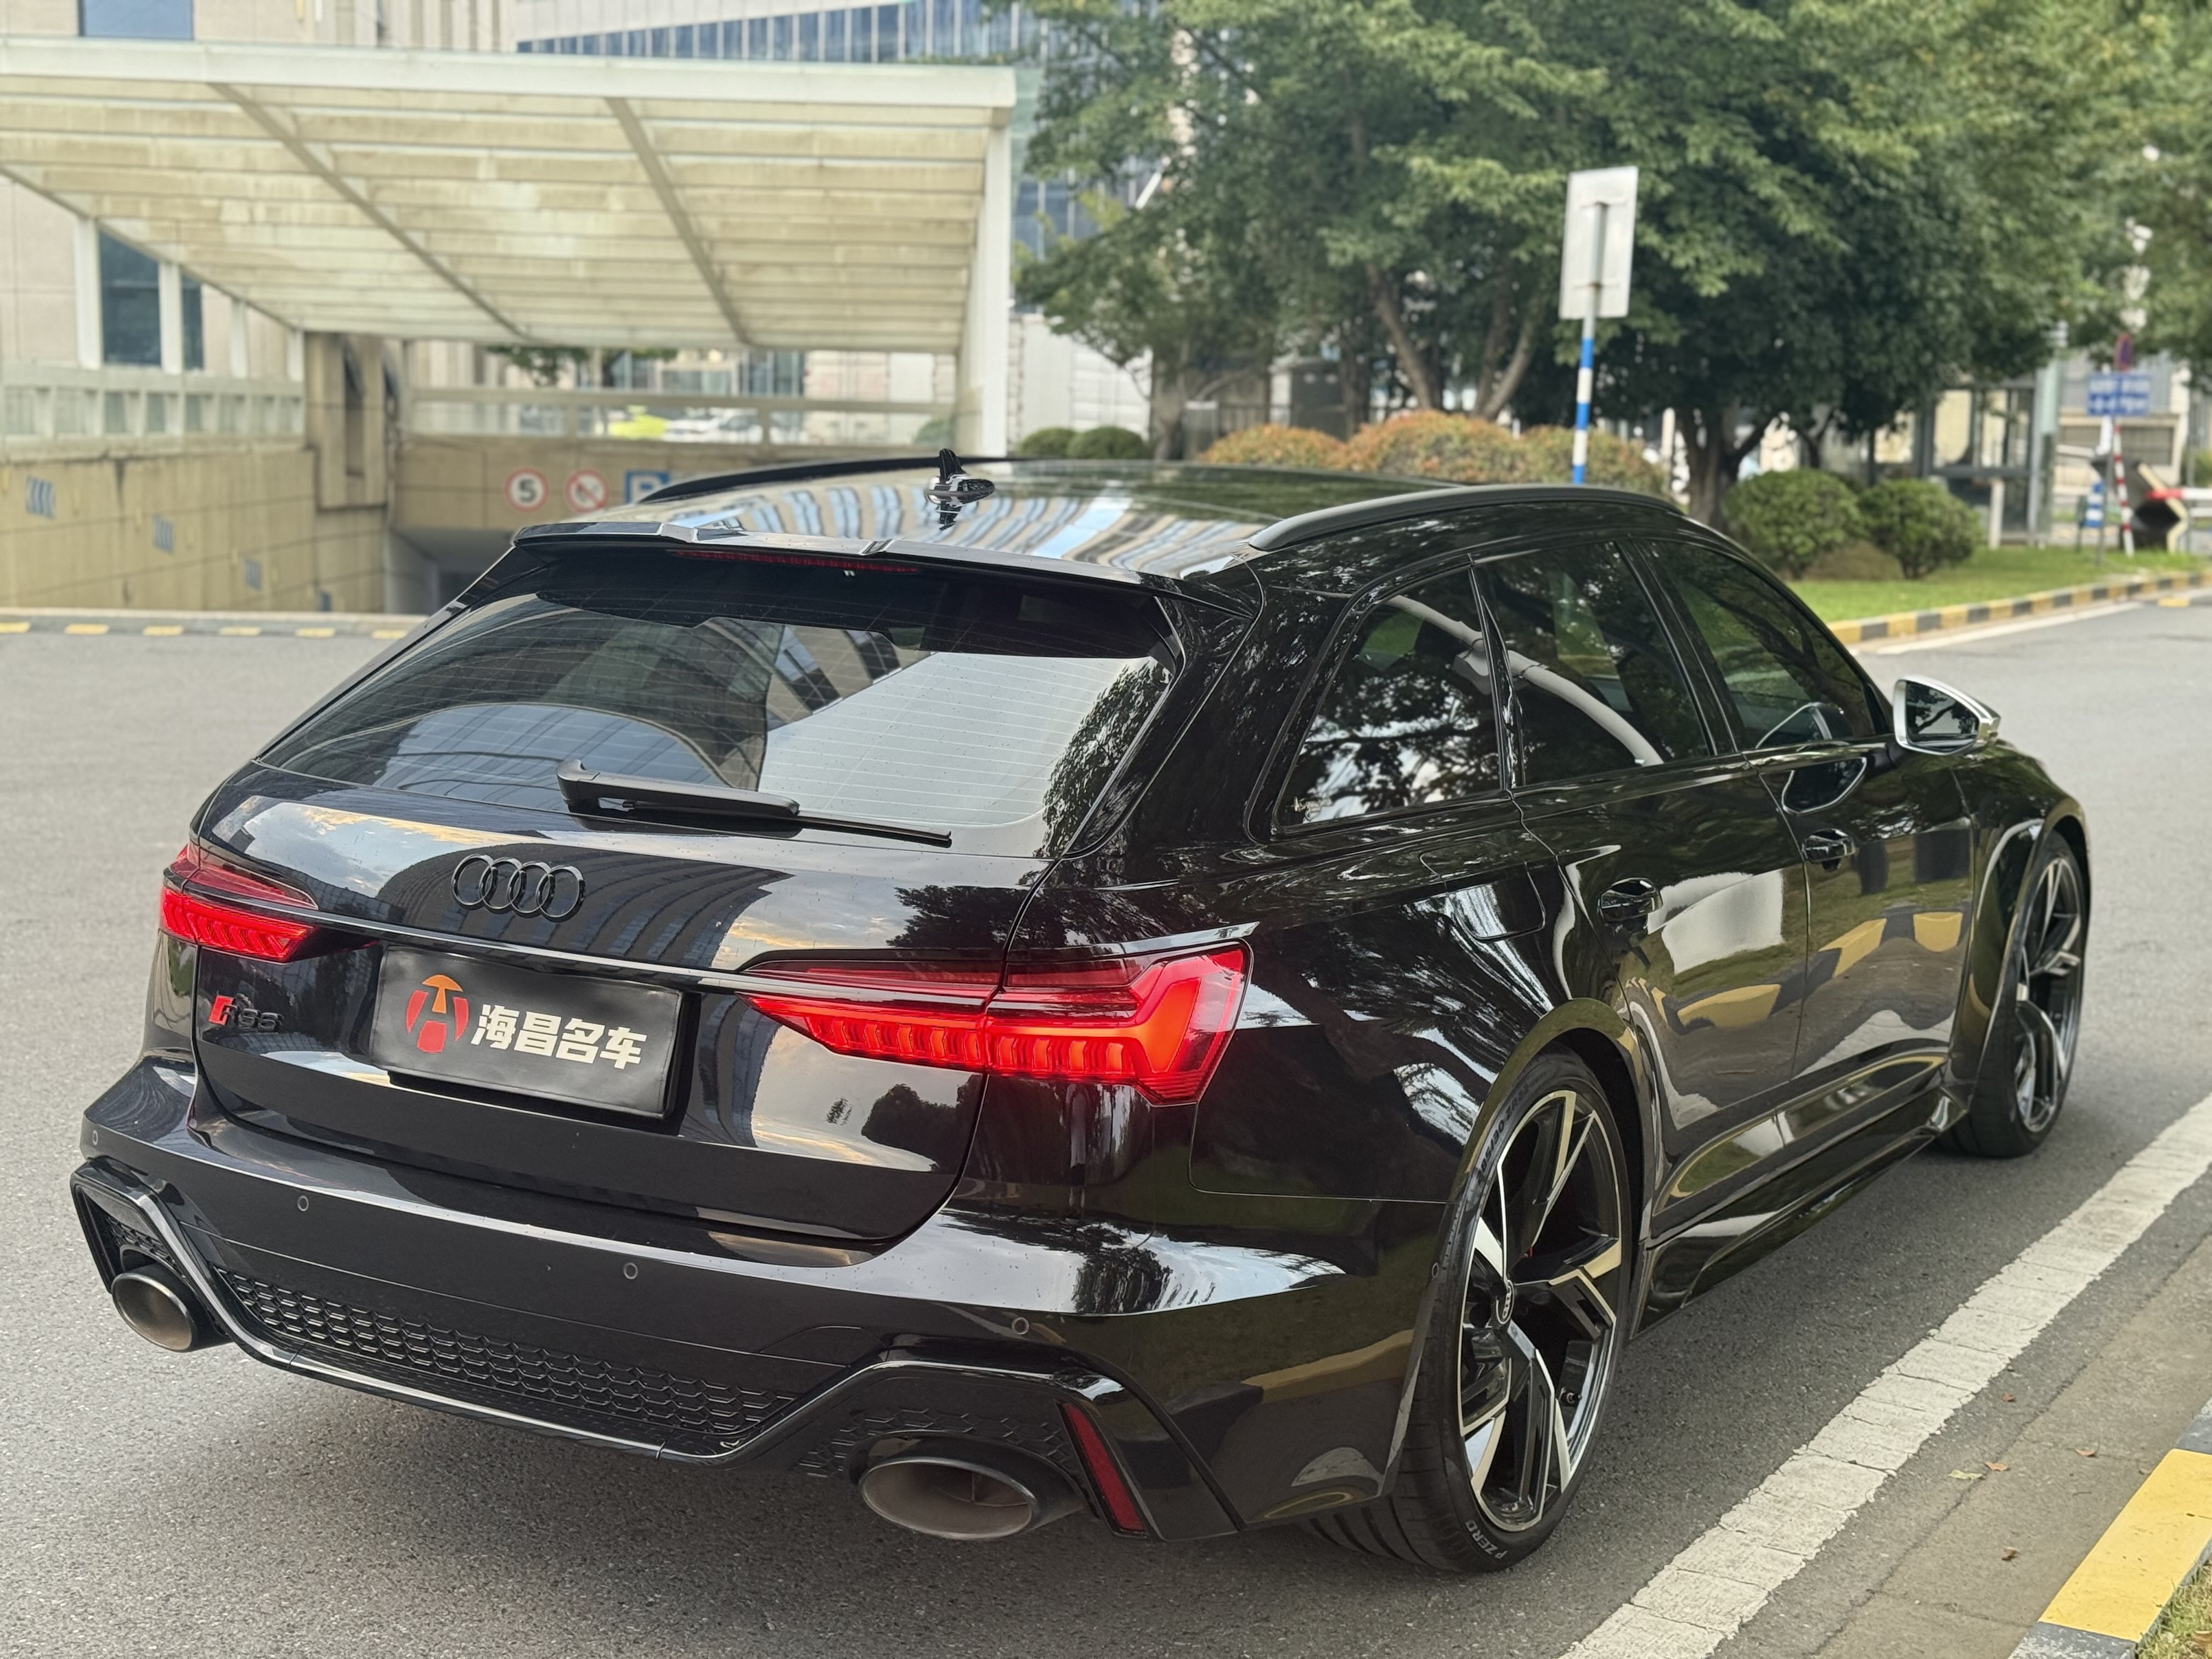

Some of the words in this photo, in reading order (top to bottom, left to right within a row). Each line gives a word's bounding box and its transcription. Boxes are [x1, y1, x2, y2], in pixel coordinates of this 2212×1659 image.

[519, 479, 537, 502] 5
[471, 1004, 647, 1069] 海昌名车
[1465, 1520, 1498, 1555] ZERO
